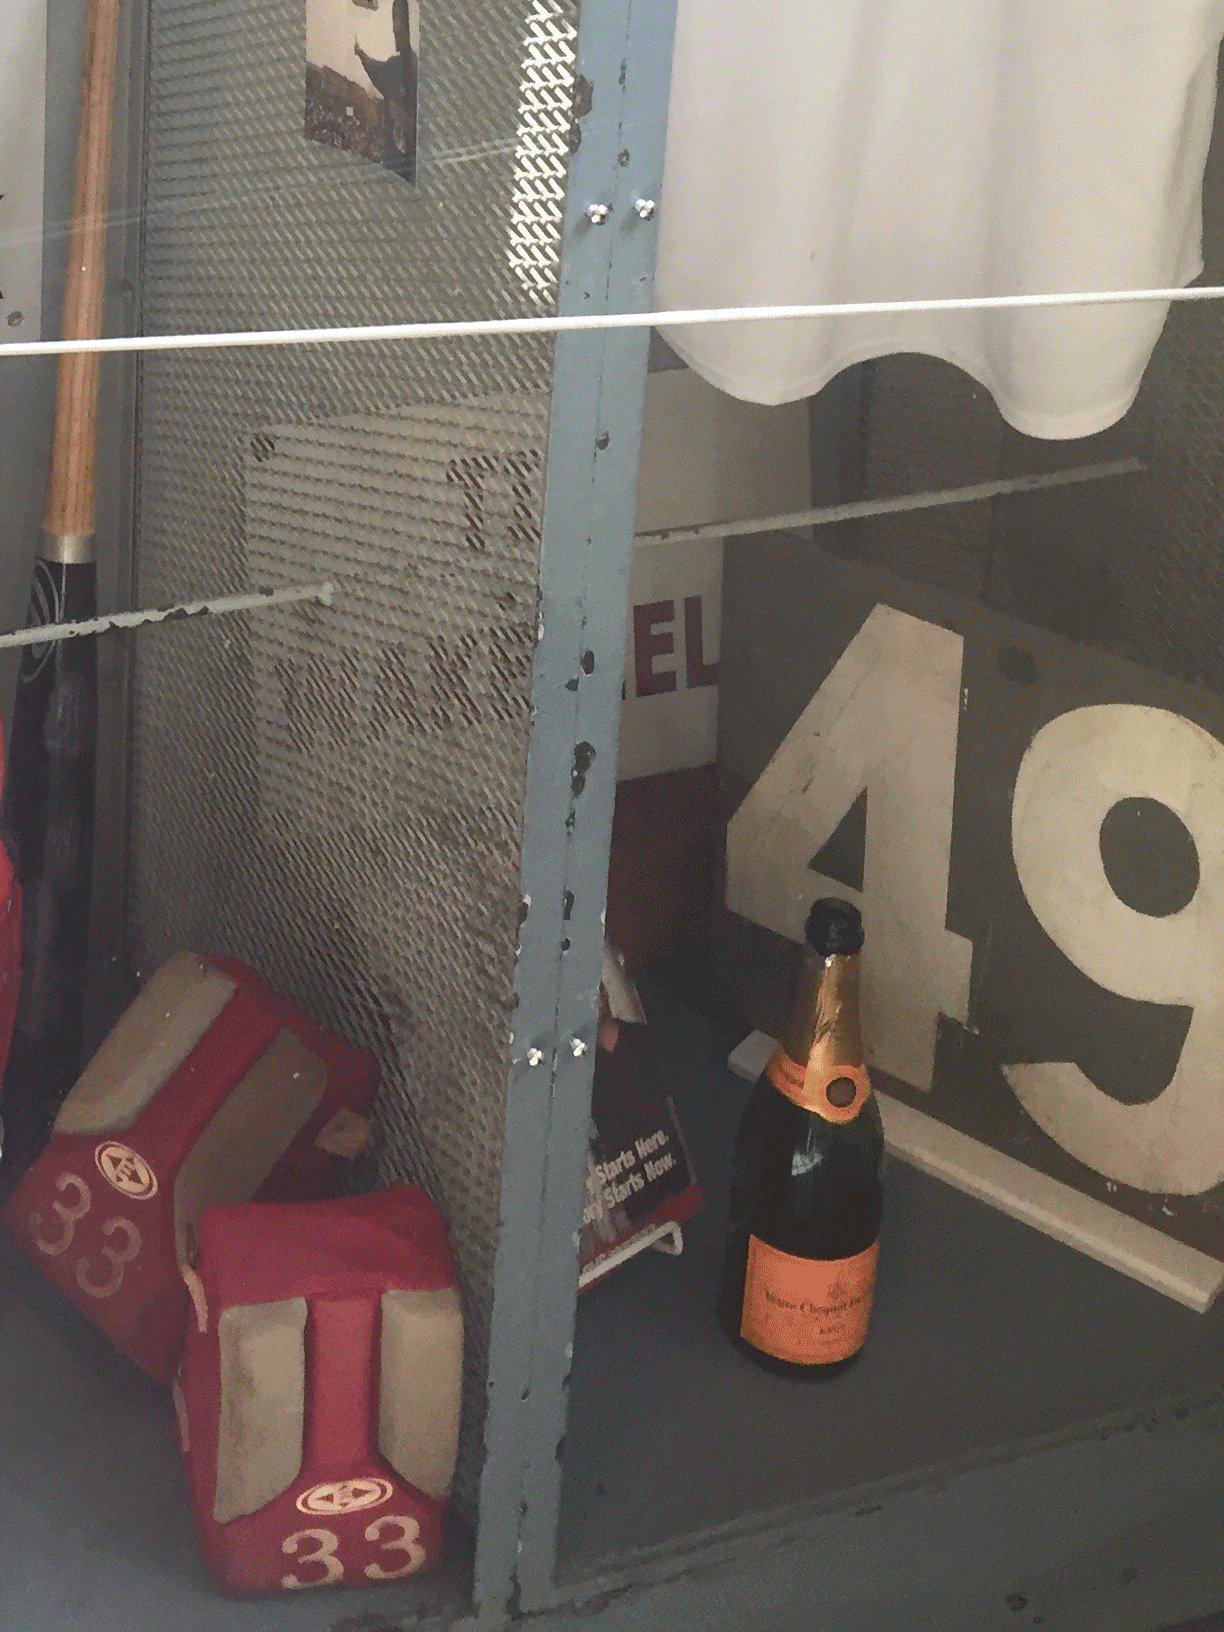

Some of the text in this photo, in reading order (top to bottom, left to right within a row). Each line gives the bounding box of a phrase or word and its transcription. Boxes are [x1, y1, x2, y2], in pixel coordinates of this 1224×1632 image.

[620, 594, 720, 700] EL
[724, 602, 1224, 1196] 49
[597, 1129, 669, 1184] Starts Here.
[604, 1172, 645, 1209] Starts
[643, 1152, 677, 1182] Now.
[28, 1171, 143, 1298] 33
[281, 1515, 427, 1590] 33
